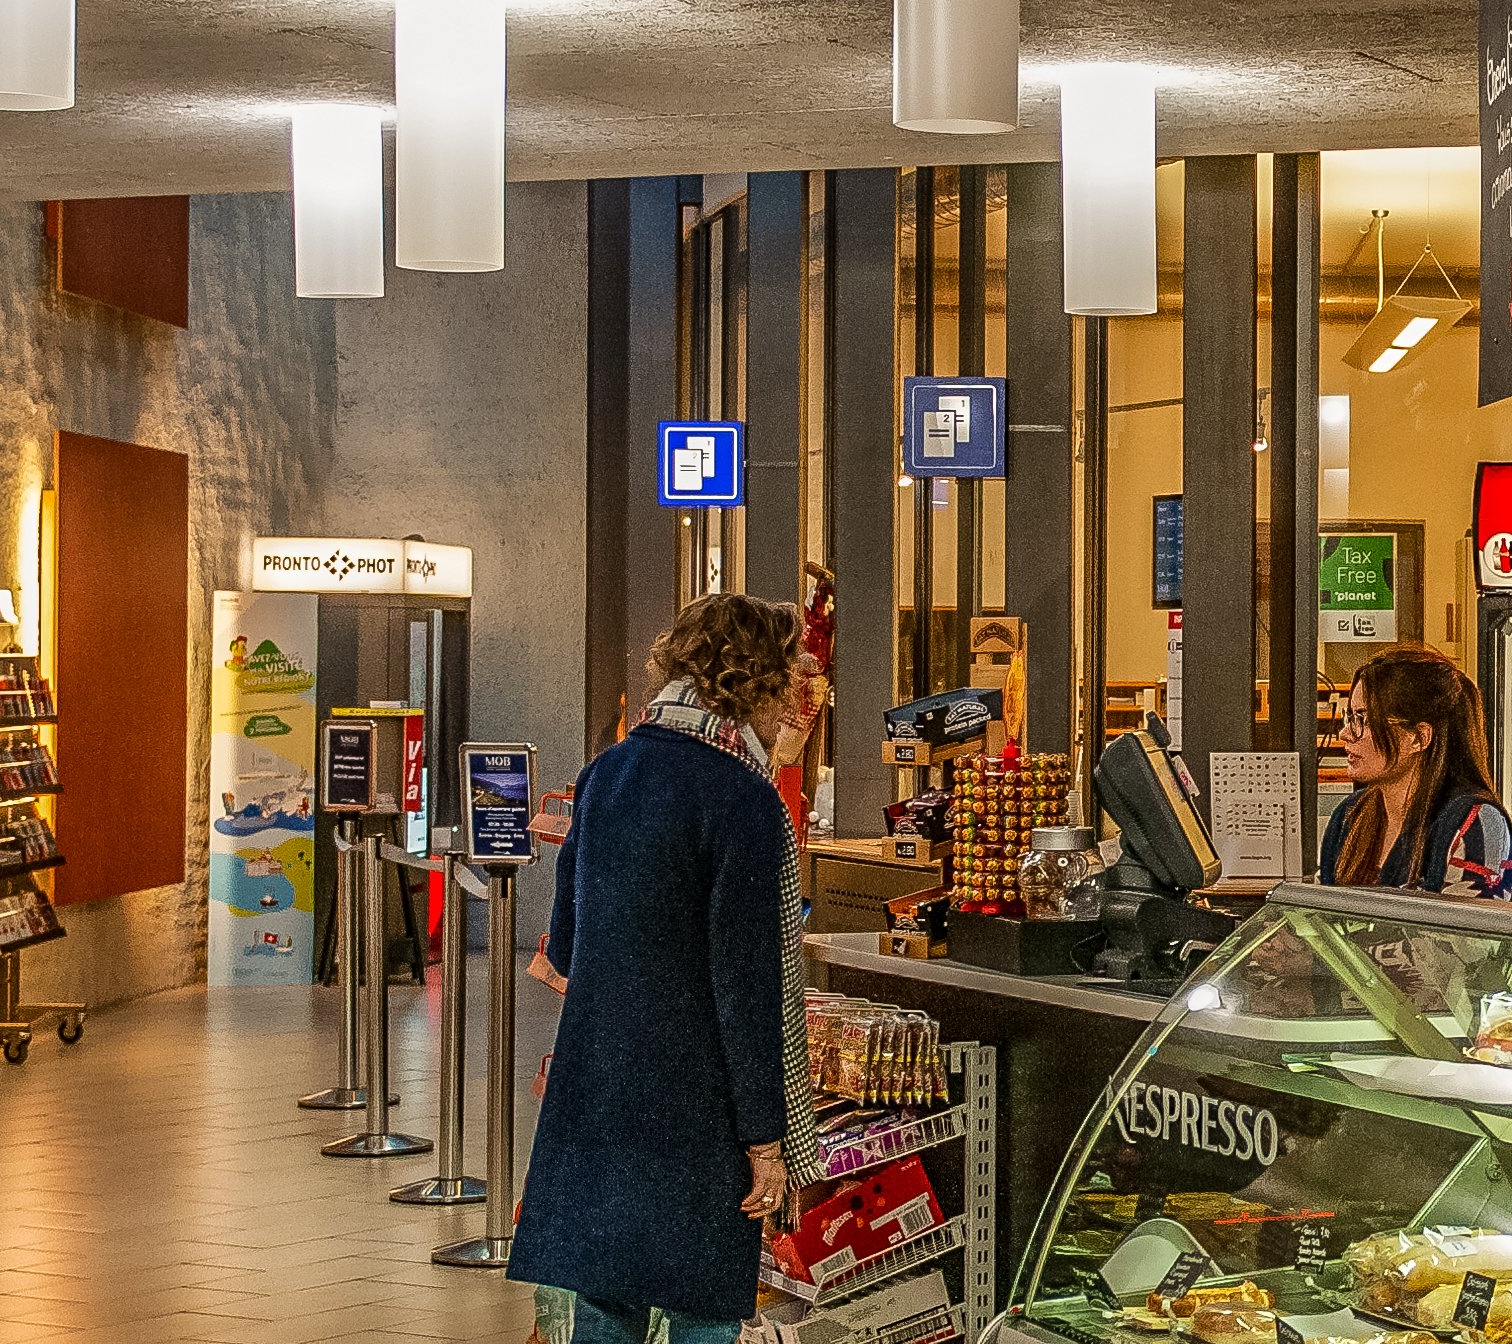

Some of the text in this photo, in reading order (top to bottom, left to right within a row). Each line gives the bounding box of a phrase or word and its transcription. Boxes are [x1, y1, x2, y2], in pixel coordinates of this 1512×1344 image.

[263, 555, 320, 571] PRONTO
[357, 558, 395, 574] PHOT
[1342, 547, 1372, 565] Tax
[1337, 566, 1376, 584] Free
[1105, 1072, 1281, 1167] NESPRESSO
